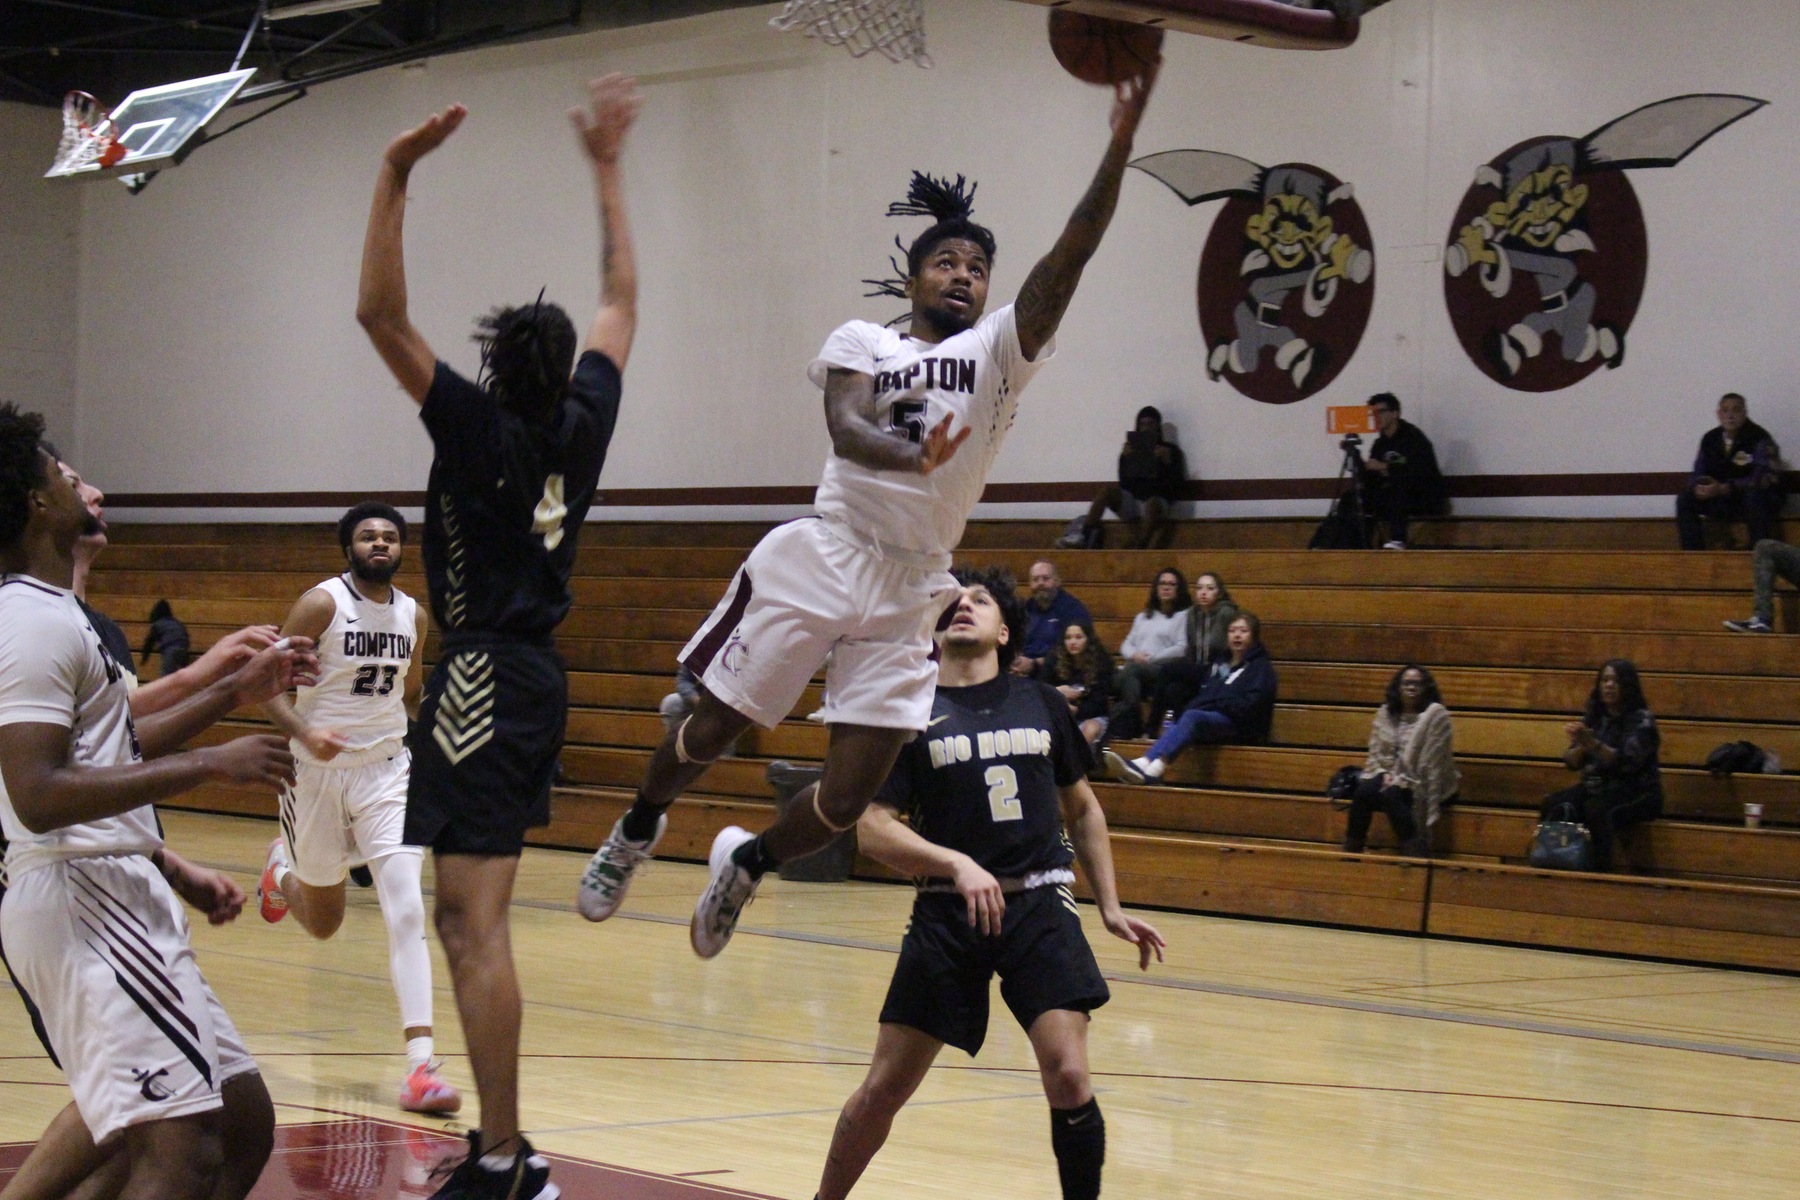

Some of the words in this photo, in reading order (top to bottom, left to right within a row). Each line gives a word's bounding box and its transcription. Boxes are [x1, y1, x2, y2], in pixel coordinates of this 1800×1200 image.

[890, 399, 927, 443] 5
[530, 473, 568, 551] 4
[344, 631, 412, 659] COMPTON
[350, 664, 399, 697] 23
[928, 734, 972, 769] RIO
[984, 764, 1024, 822] 2
